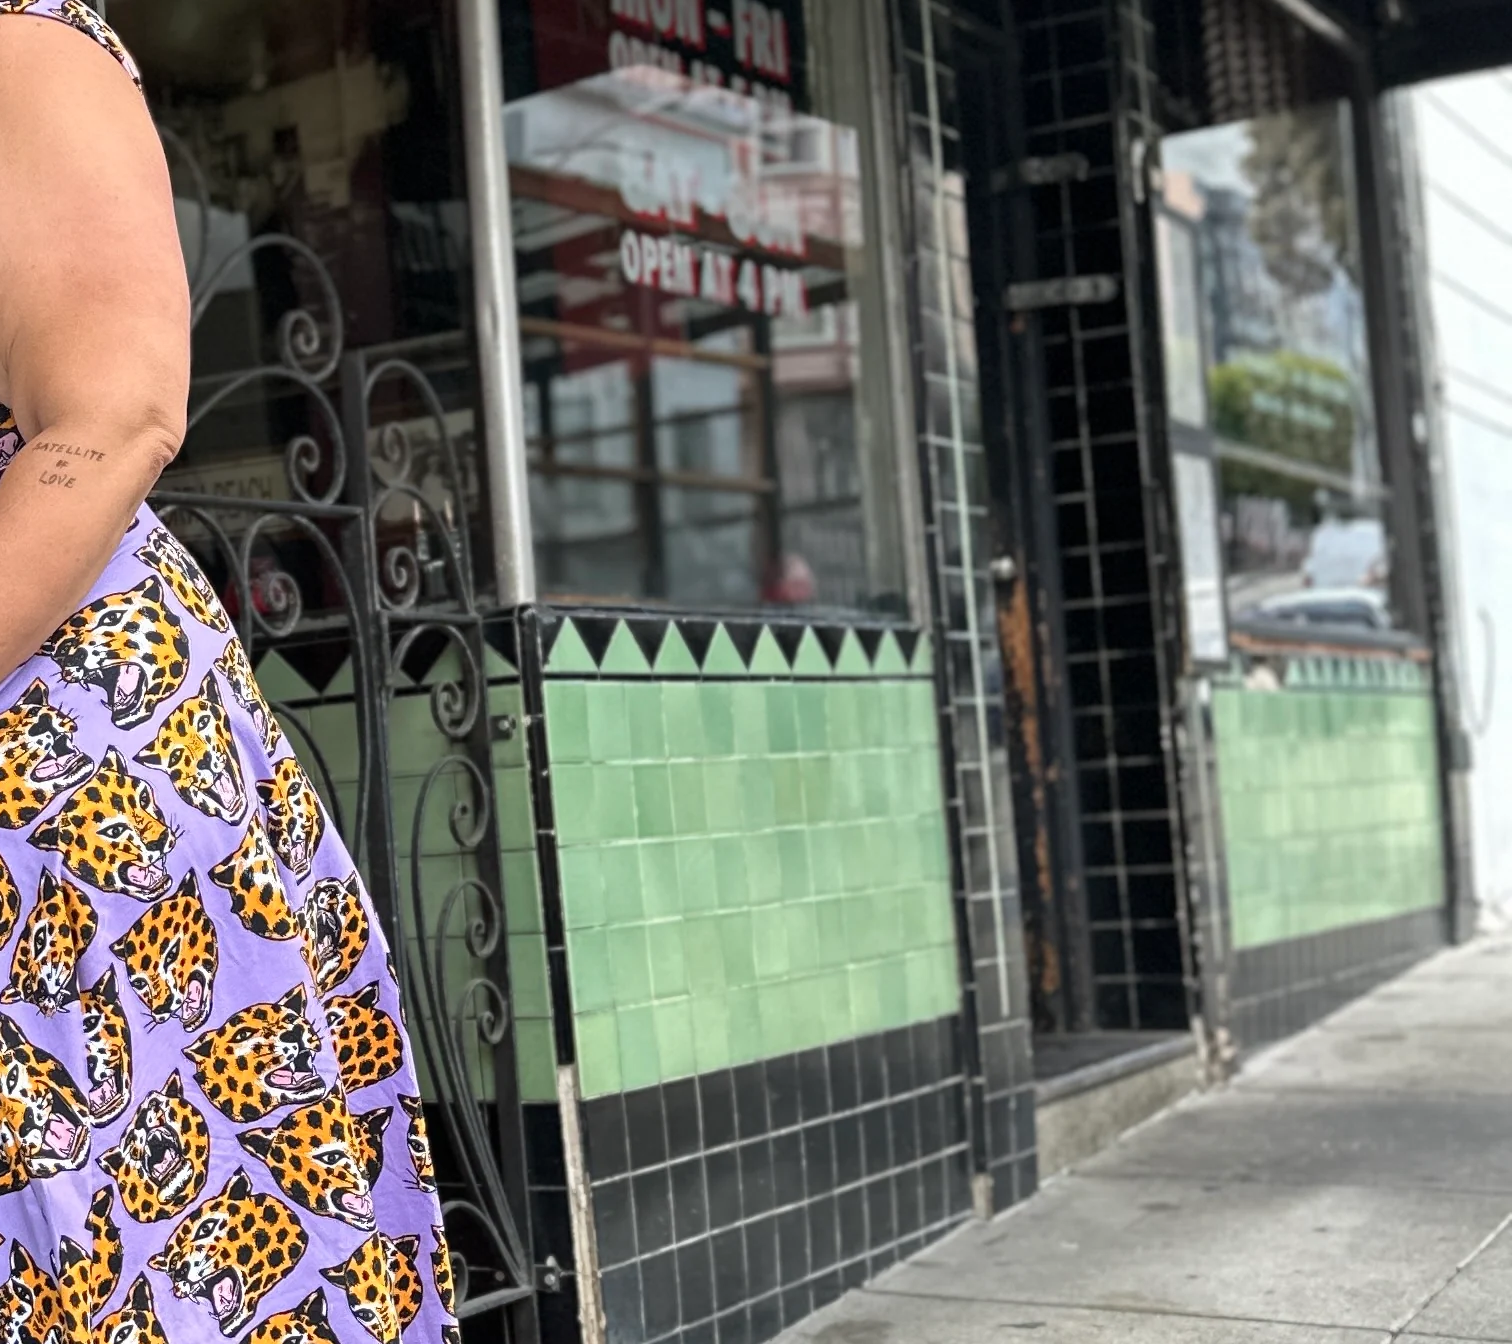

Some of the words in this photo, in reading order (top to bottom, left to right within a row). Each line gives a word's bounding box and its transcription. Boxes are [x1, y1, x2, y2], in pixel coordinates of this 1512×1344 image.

[620, 228, 700, 296] OPEN
[701, 249, 739, 307] AT
[737, 257, 763, 313] 4
[761, 262, 810, 319] PM
[32, 441, 106, 462] SATELLITE
[38, 469, 77, 489] LOVE
